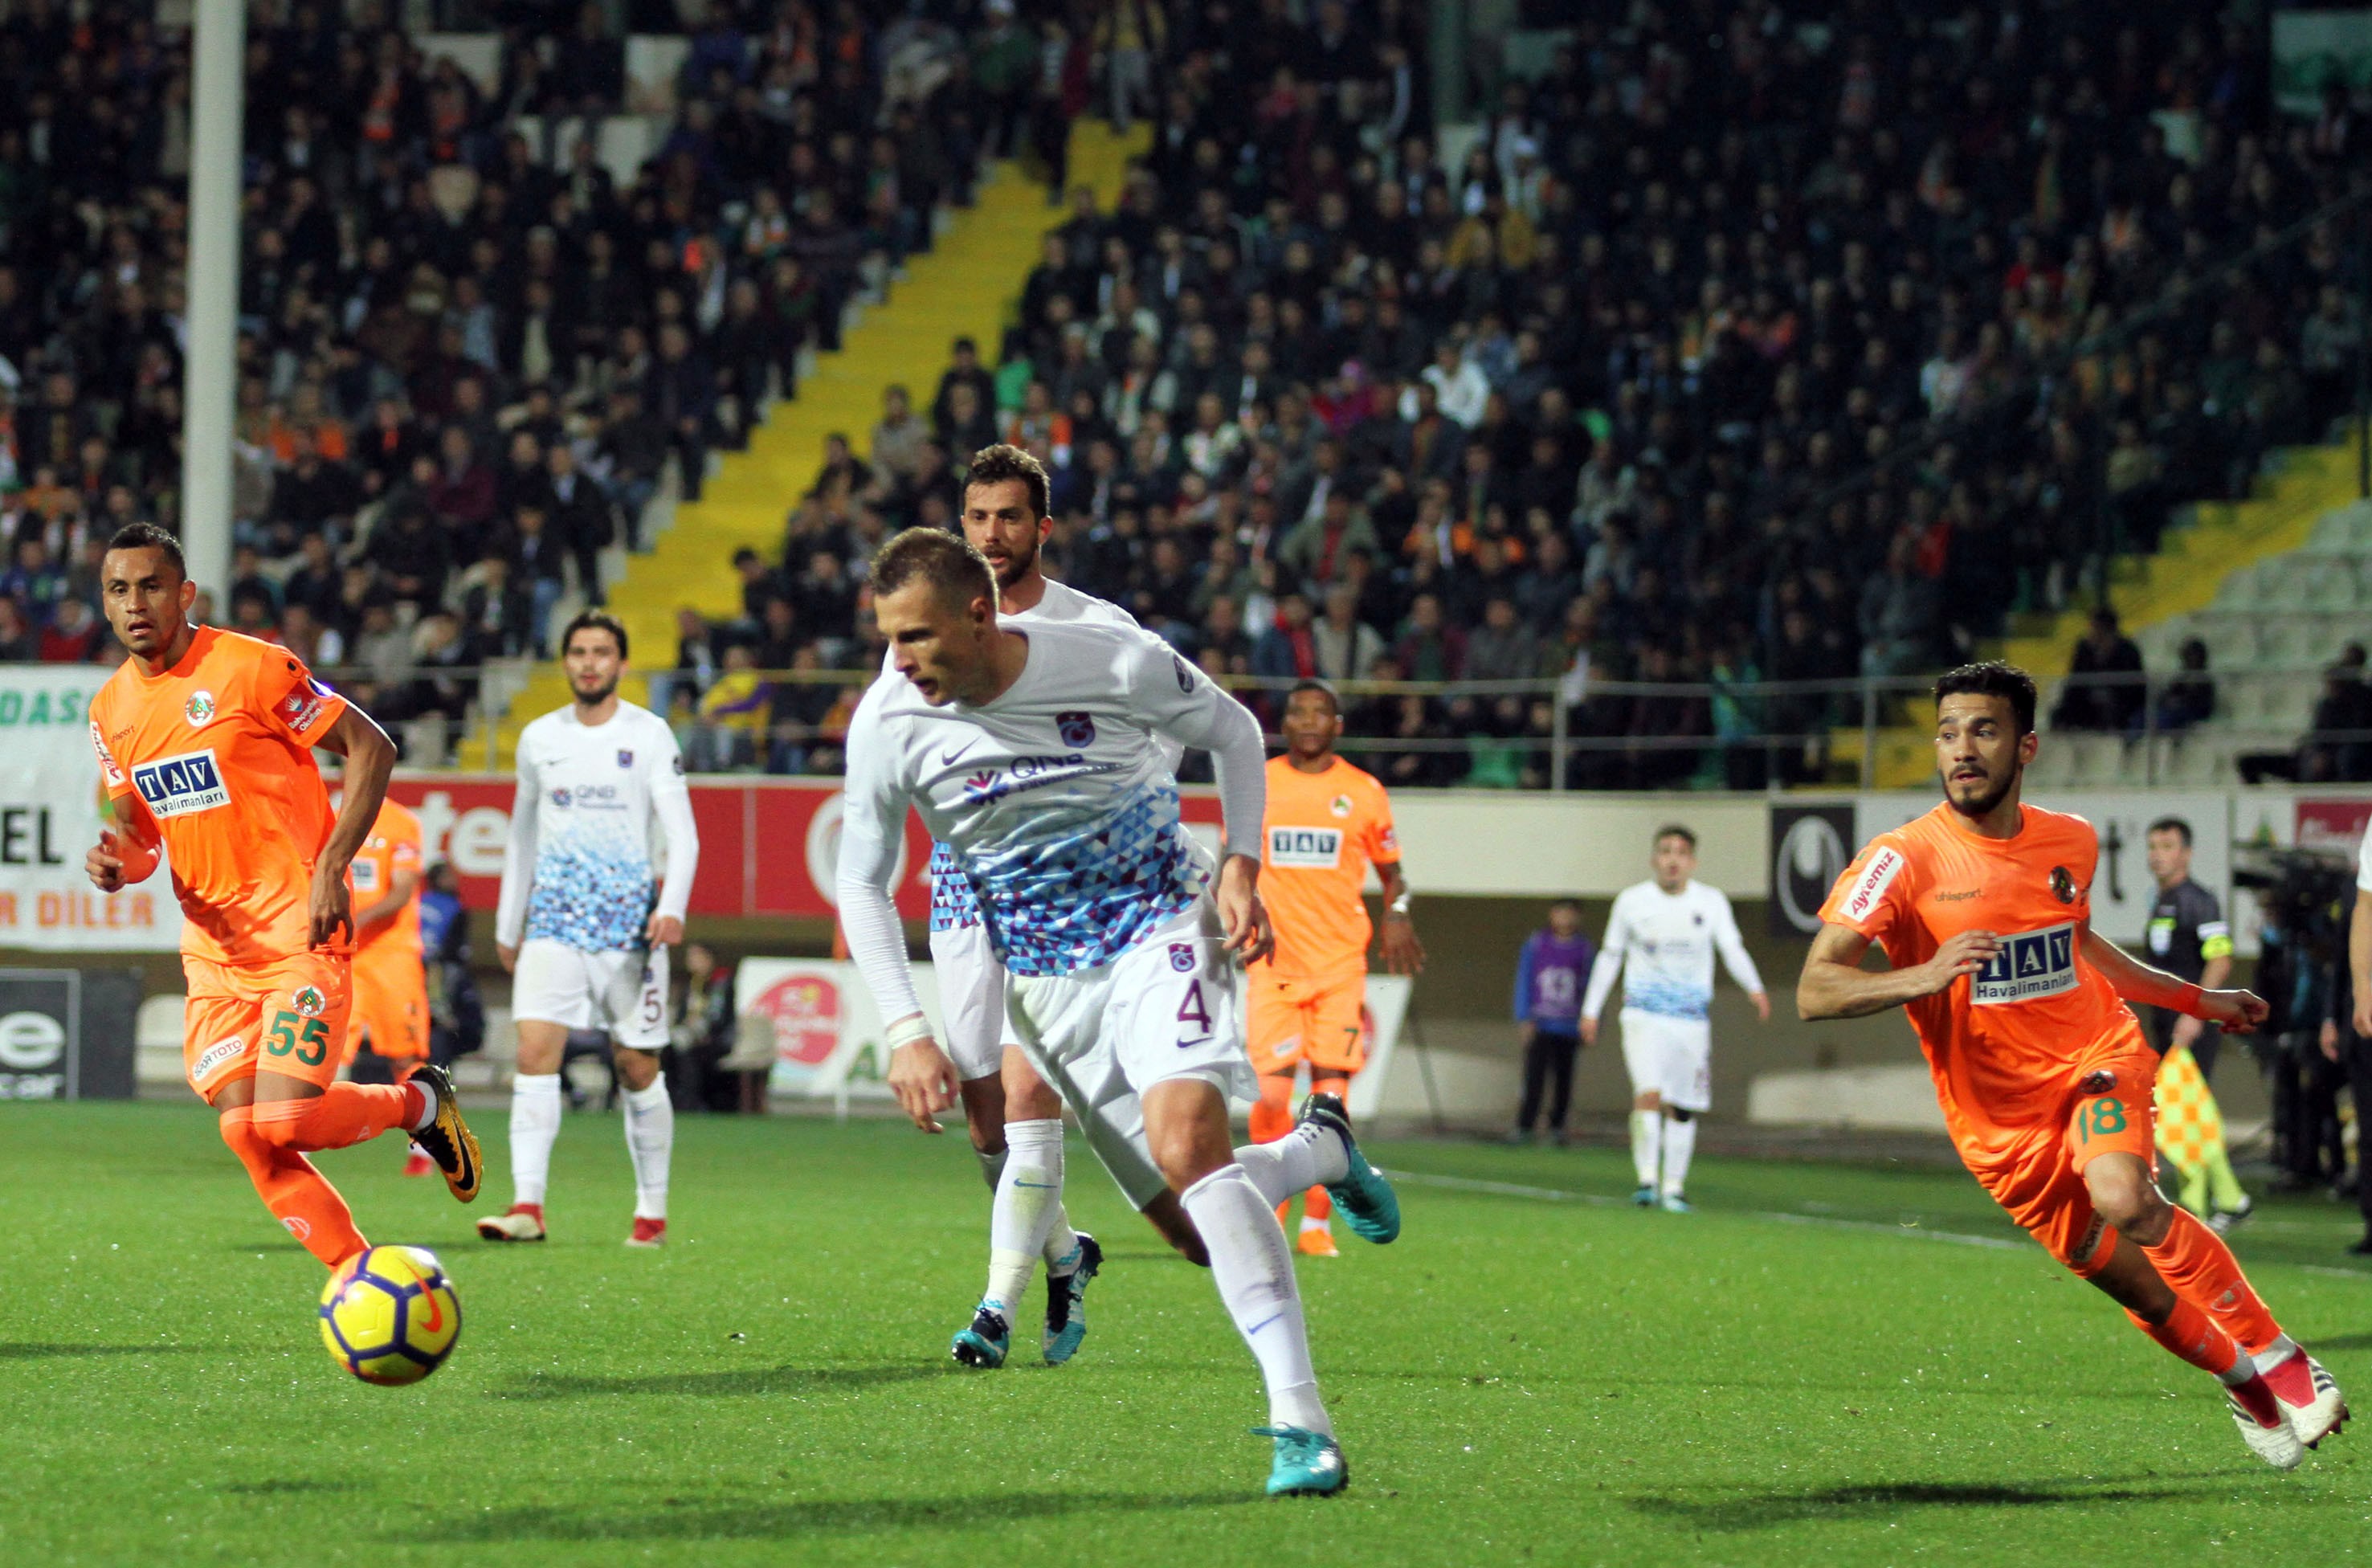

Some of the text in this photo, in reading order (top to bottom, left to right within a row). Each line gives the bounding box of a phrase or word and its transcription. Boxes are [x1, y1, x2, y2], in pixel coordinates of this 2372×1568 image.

[138, 761, 207, 799] TAV
[3, 806, 64, 864] EL
[1851, 851, 1895, 915] Aytemiz
[1986, 935, 2068, 978] TAV
[644, 989, 662, 1023] 5
[1176, 978, 1211, 1033] 4
[267, 1011, 329, 1066] 55
[1344, 1027, 1359, 1056] 7
[2079, 1097, 2127, 1145] 18
